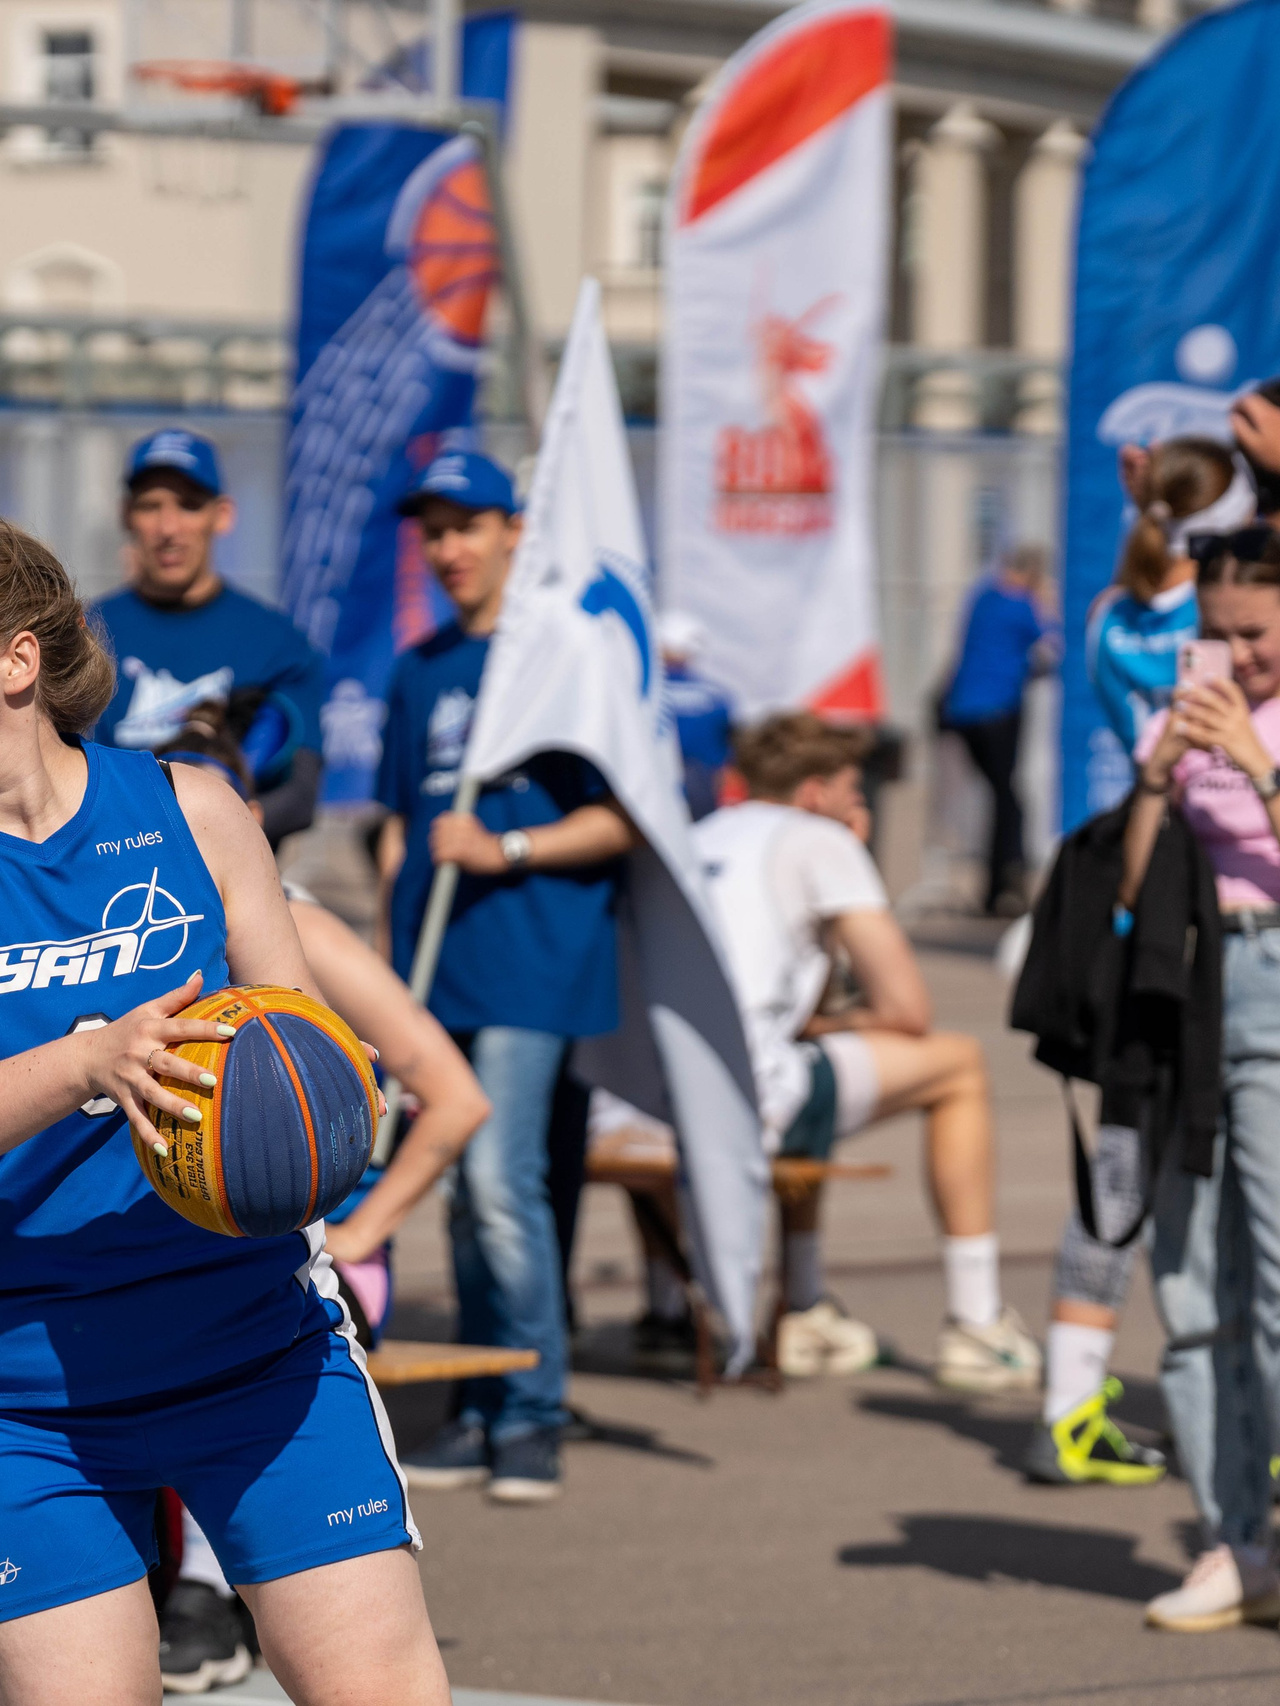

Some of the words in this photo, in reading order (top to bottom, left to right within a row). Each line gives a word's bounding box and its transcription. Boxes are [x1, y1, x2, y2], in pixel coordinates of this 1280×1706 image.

[95, 840, 121, 856] my
[124, 830, 163, 850] rules
[195, 1131, 203, 1156] BALL
[186, 1165, 199, 1188] FIBA
[195, 1157, 211, 1201] OFFICIAL
[327, 1507, 354, 1527] my
[357, 1498, 388, 1518] rules
